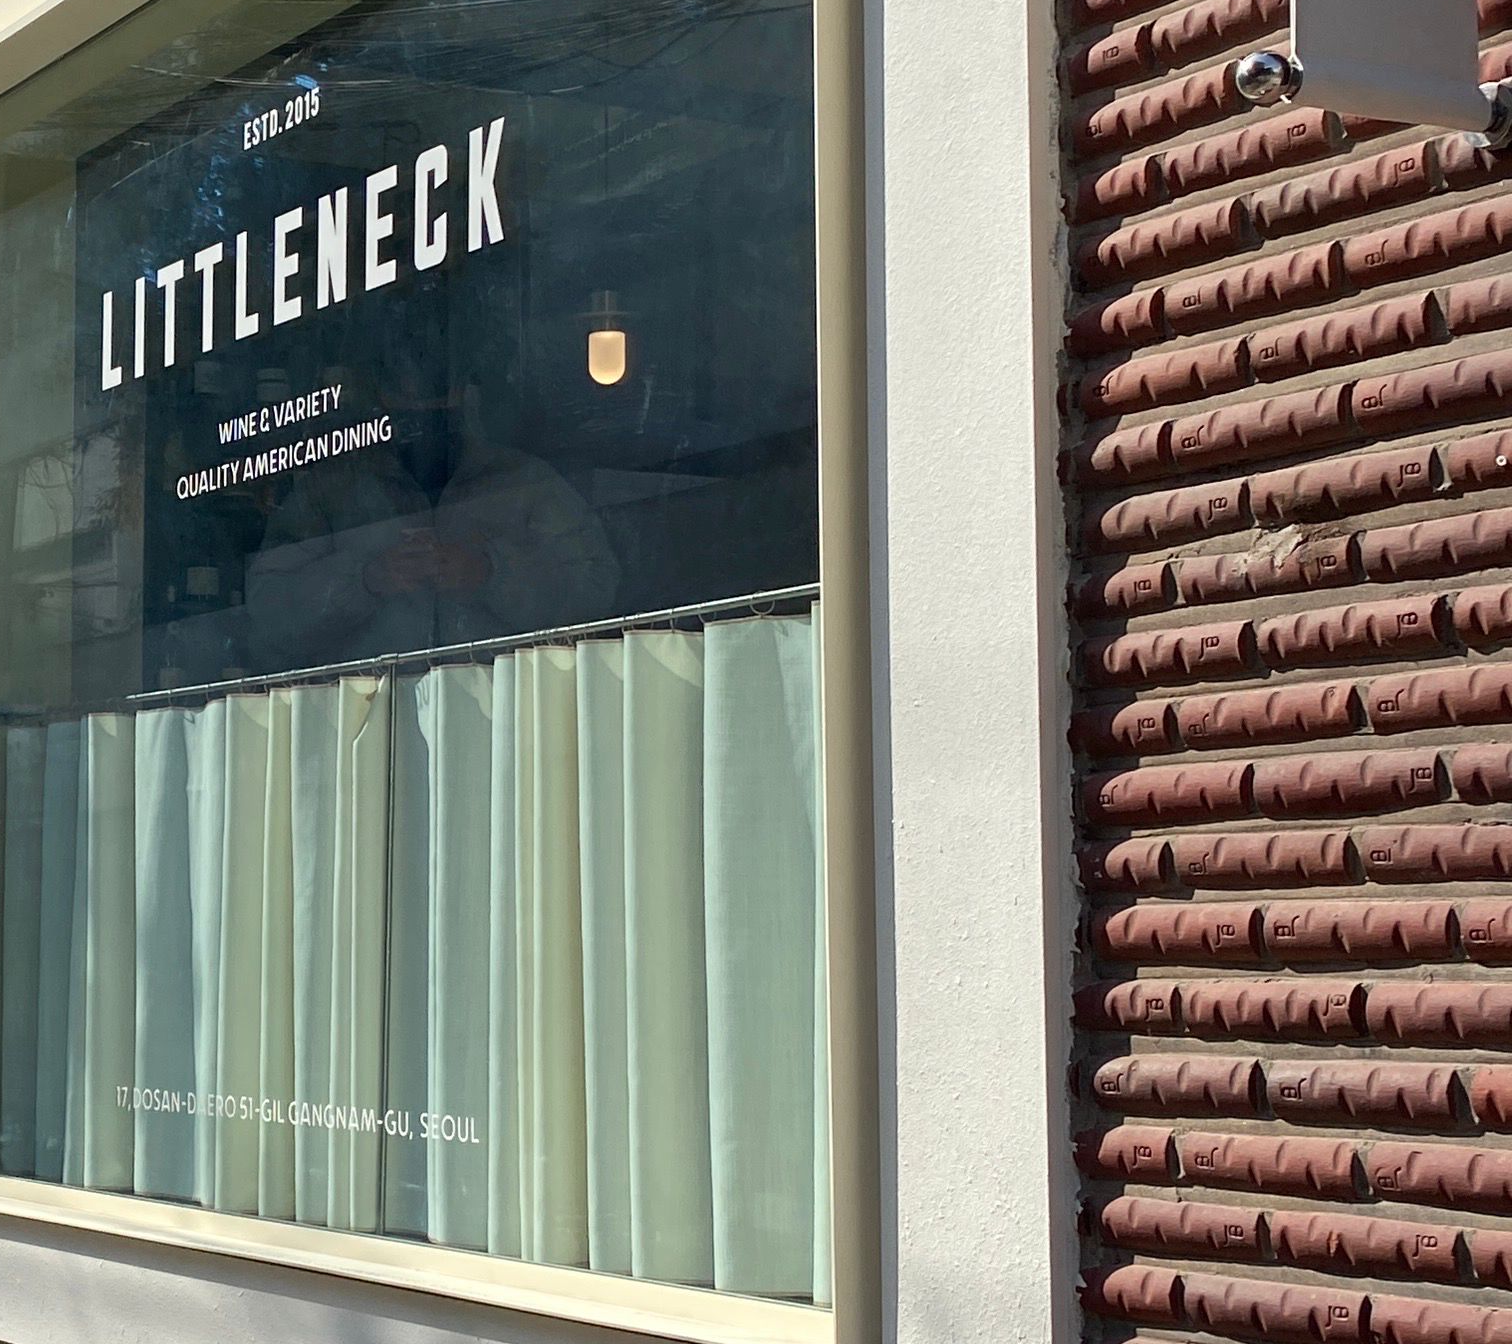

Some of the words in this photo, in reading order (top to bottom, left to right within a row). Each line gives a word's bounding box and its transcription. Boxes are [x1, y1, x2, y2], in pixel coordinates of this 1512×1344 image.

[244, 108, 283, 150] ESTD.
[285, 86, 320, 130] 2015
[101, 116, 506, 391] LITTLENECK
[218, 412, 257, 445] WINE
[259, 407, 270, 433] &
[273, 384, 342, 428] VARIETY
[176, 460, 240, 500] QUALITY
[242, 433, 328, 482] AMERICAN
[331, 415, 392, 457] DINING
[239, 1096, 285, 1124] 51-GIL
[288, 1101, 414, 1140] GANGNAM-GU,
[420, 1112, 480, 1144] SEOUL
